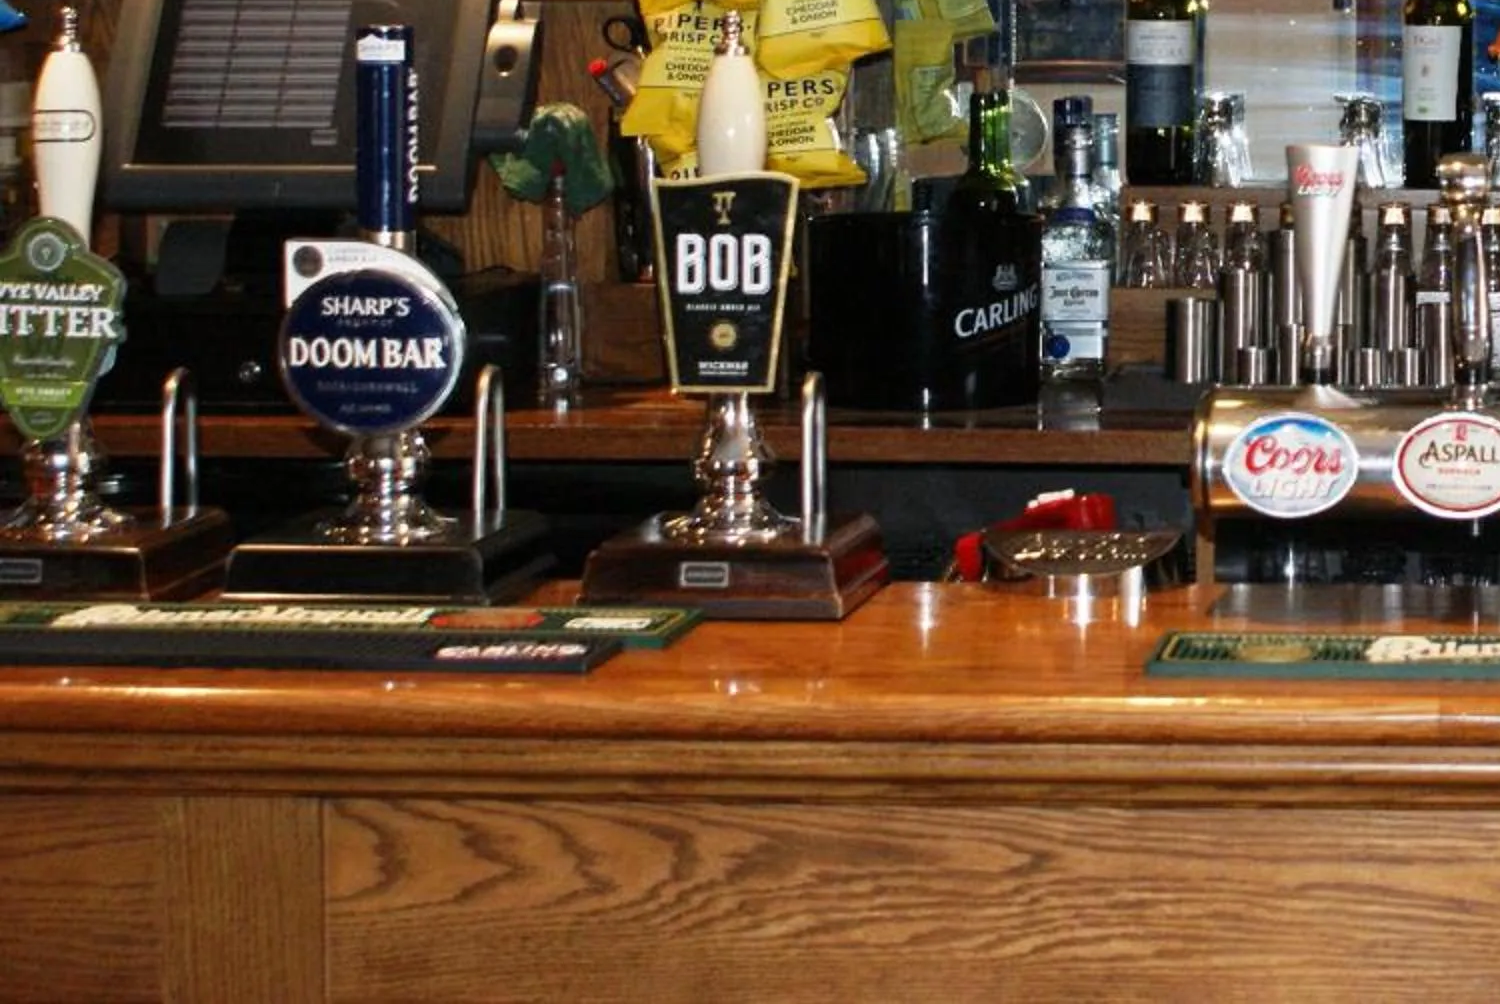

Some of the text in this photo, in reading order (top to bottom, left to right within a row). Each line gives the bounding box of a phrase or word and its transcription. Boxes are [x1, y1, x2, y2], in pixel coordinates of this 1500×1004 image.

[710, 35, 721, 45] C
[665, 62, 710, 72] CHEDDA
[675, 72, 705, 81] ONIO
[768, 79, 834, 98] PERS
[765, 98, 799, 112] RISP
[676, 232, 772, 295] BOB
[34, 283, 105, 301] VALLEY
[321, 297, 411, 316] SHARP'S
[955, 285, 1038, 338] CARLING
[0, 305, 118, 338] ITTER
[289, 337, 447, 368] DOOM BAR
[1244, 436, 1343, 475] Coors
[1419, 440, 1500, 469] ASPALL
